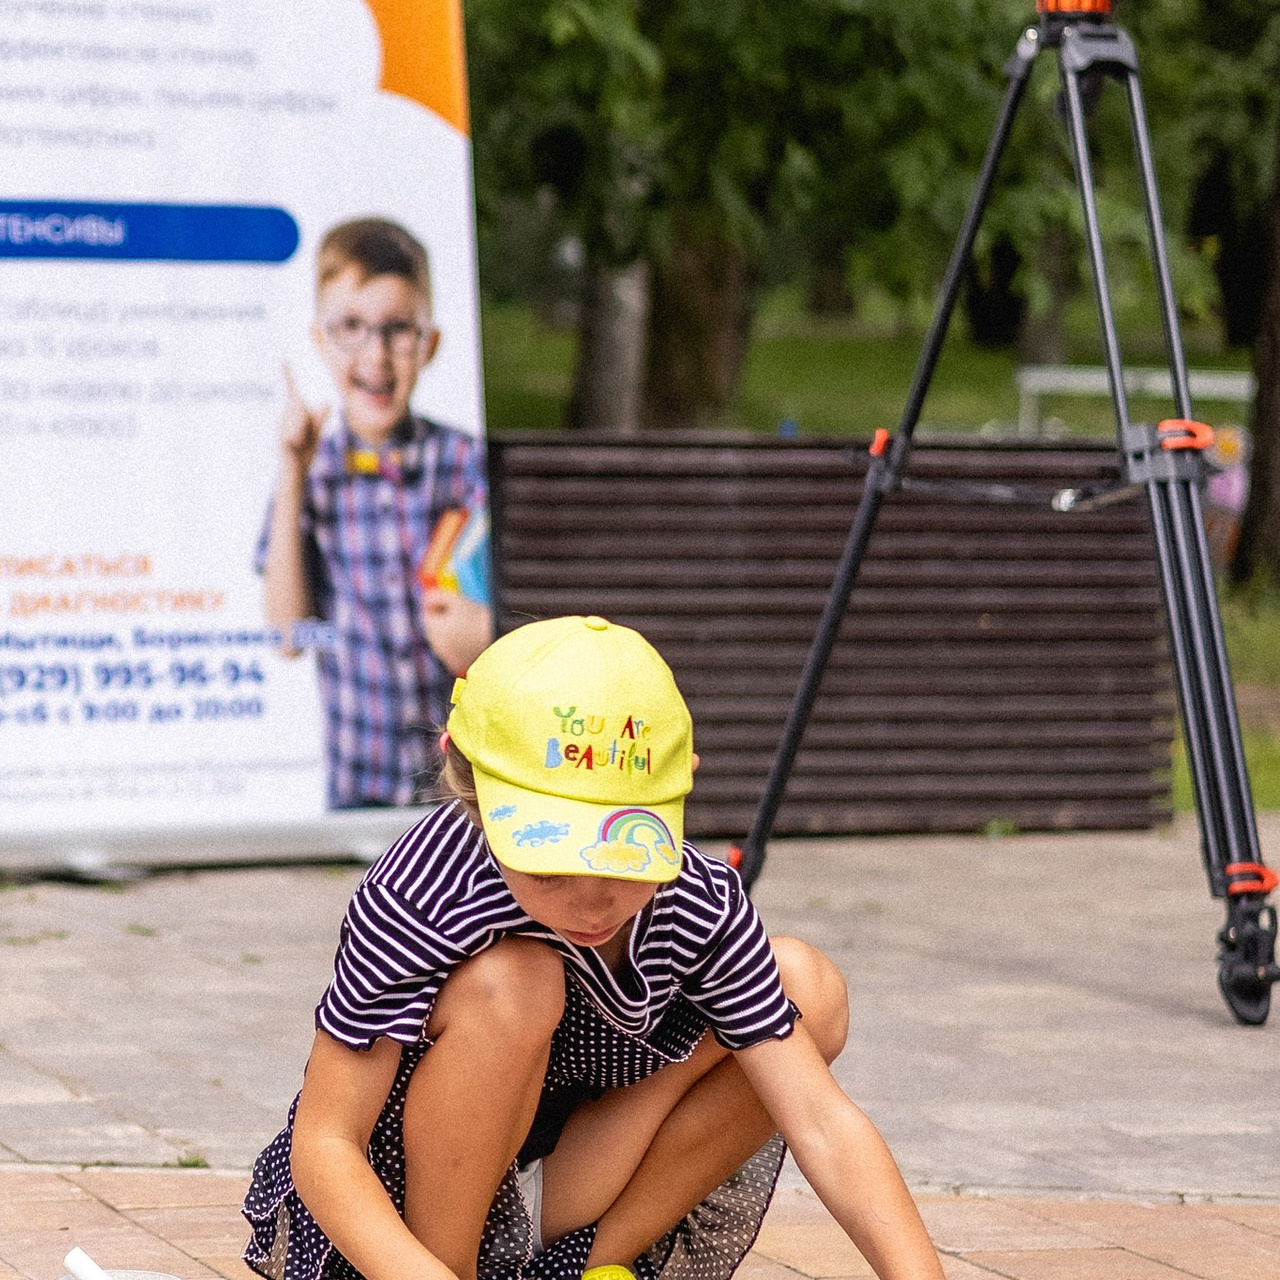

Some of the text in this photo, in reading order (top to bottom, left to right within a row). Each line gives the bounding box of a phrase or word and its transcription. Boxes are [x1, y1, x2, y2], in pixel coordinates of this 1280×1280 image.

[8, 589, 226, 617] ДИАГНОСТИКУ
[92, 659, 267, 691] 995-96-94
[620, 714, 653, 741] Are
